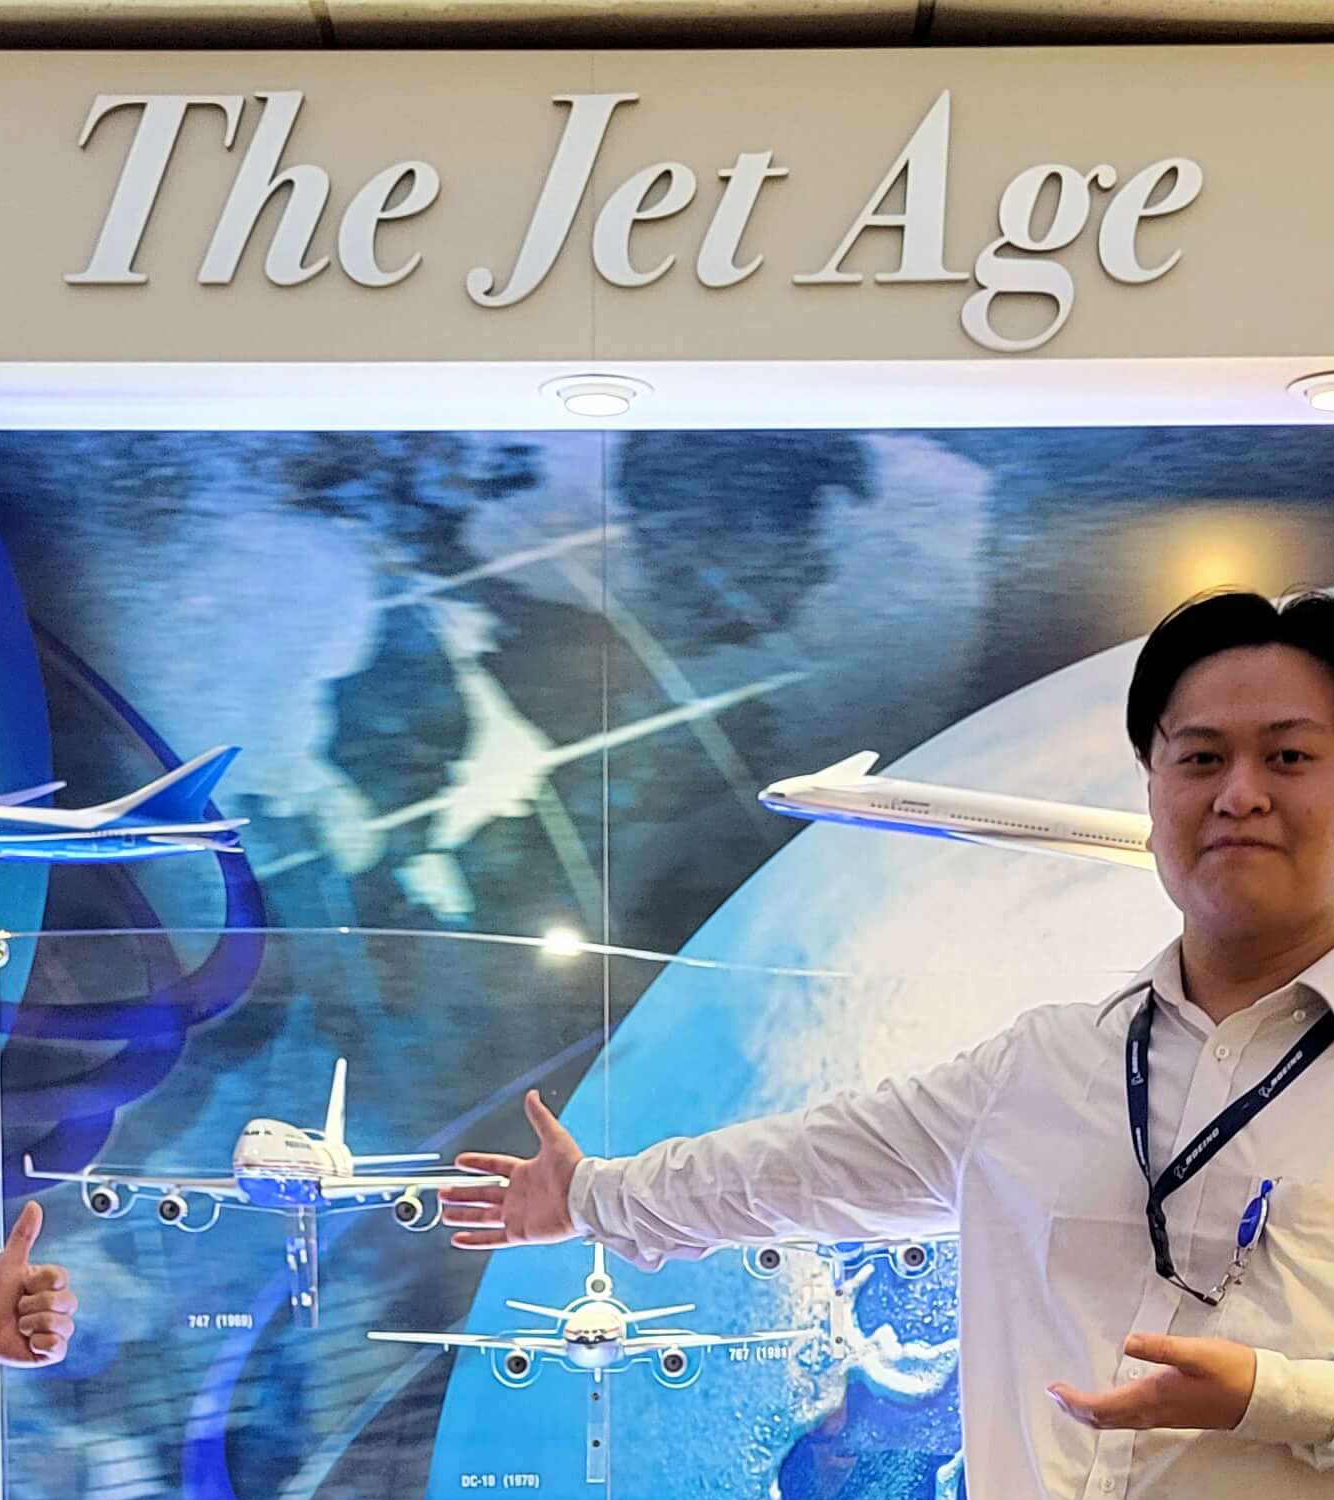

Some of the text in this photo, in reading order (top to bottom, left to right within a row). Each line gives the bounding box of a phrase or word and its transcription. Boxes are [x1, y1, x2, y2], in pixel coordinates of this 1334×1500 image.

[64, 89, 1205, 353] The Jet Age
[187, 1314, 210, 1328] 747
[461, 1474, 540, 1489] DC-10 (1970)
